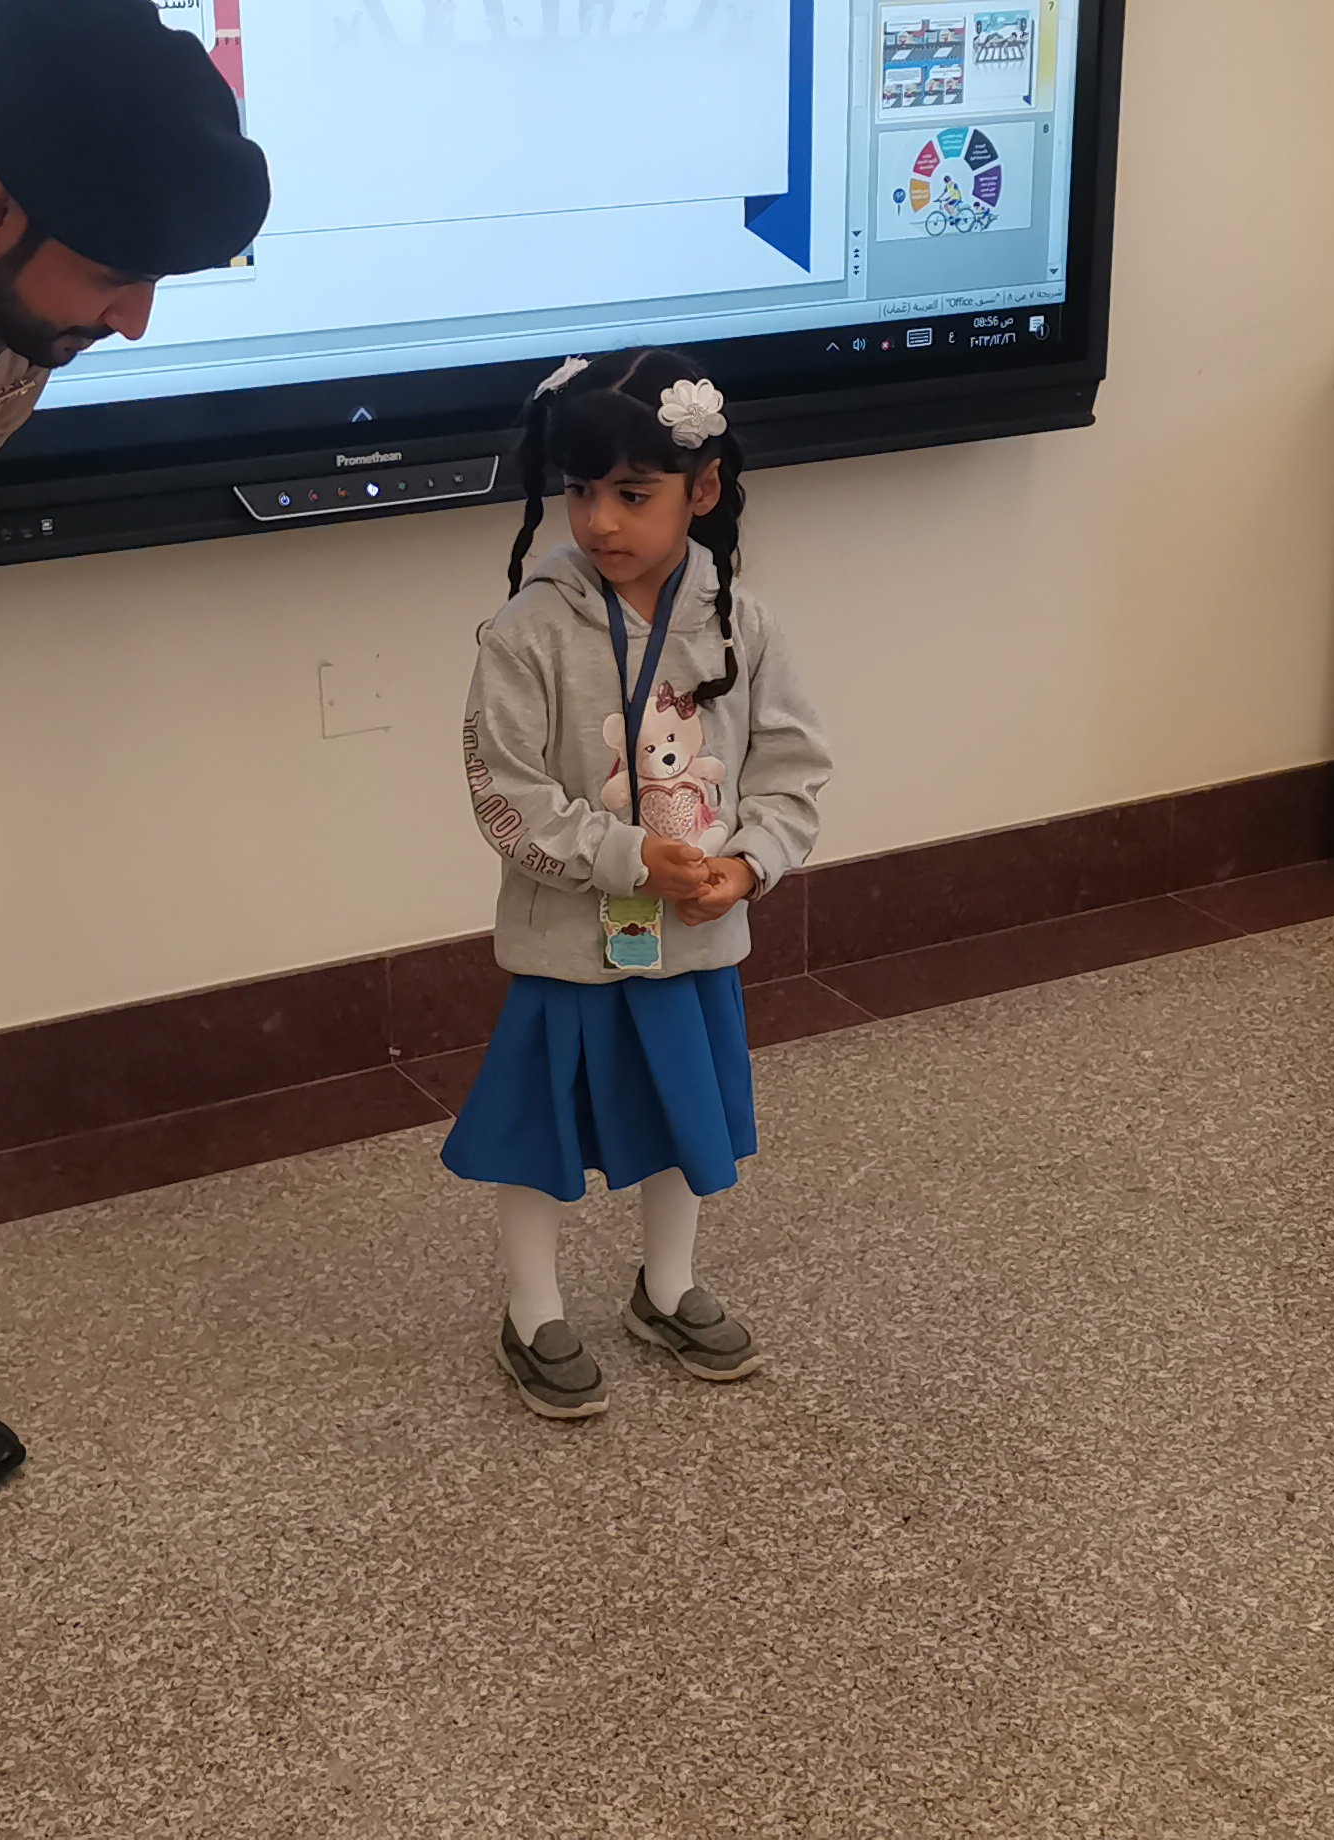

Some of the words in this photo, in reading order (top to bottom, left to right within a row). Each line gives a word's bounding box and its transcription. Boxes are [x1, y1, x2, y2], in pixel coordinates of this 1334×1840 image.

[336, 451, 402, 467] Promethean
[475, 793, 530, 858] YOU
[520, 842, 565, 877] BE
